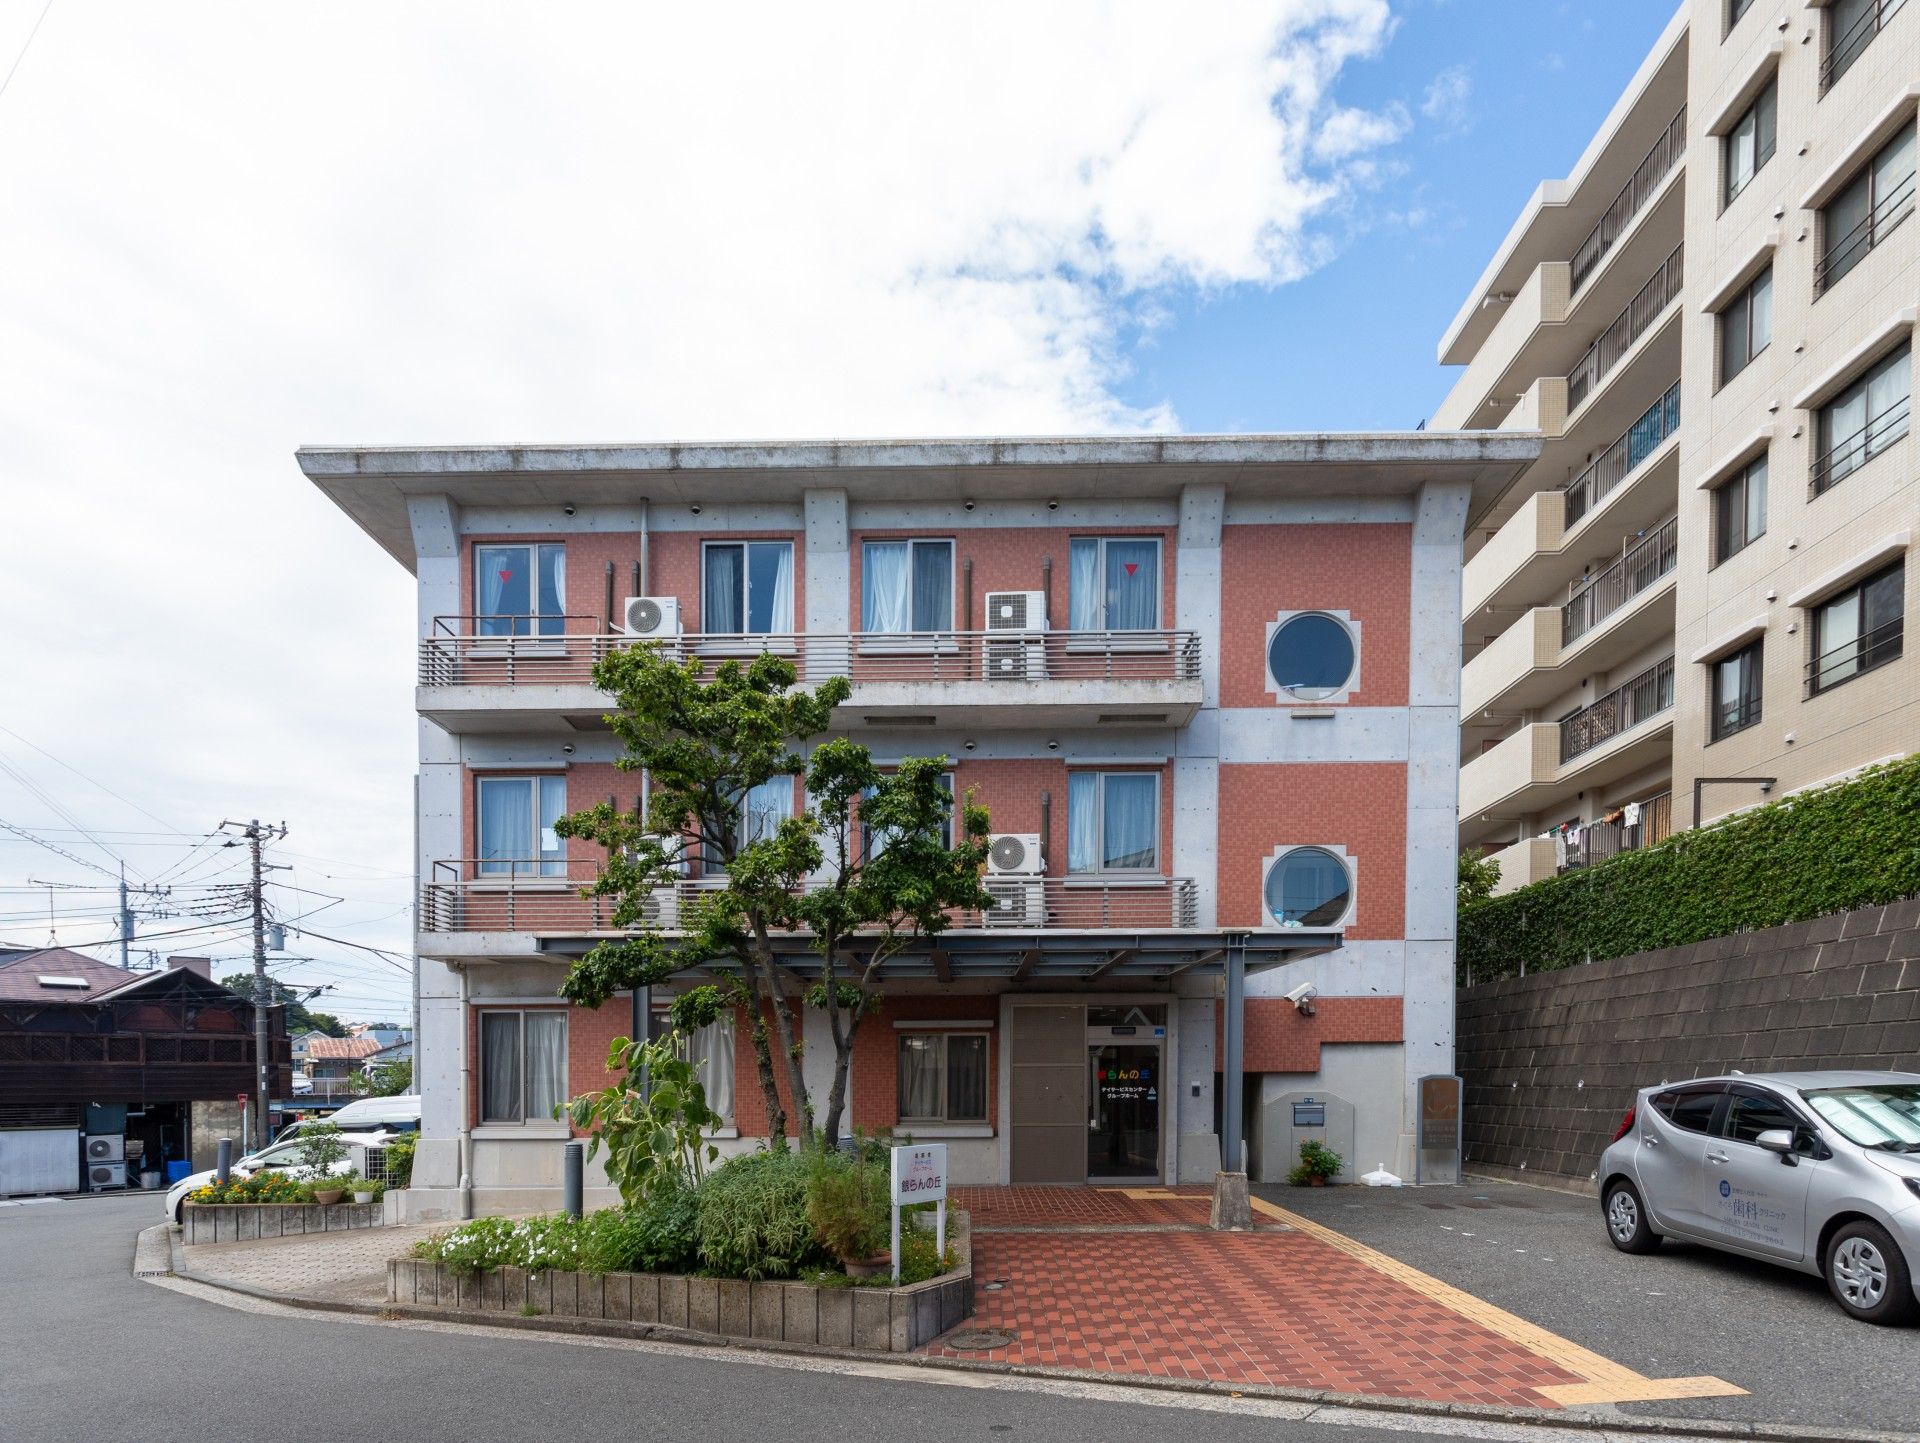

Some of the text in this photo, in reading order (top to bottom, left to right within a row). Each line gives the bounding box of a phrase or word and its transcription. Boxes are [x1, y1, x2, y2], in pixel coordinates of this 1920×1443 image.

[901, 1176, 942, 1192] 銀らんの丘
